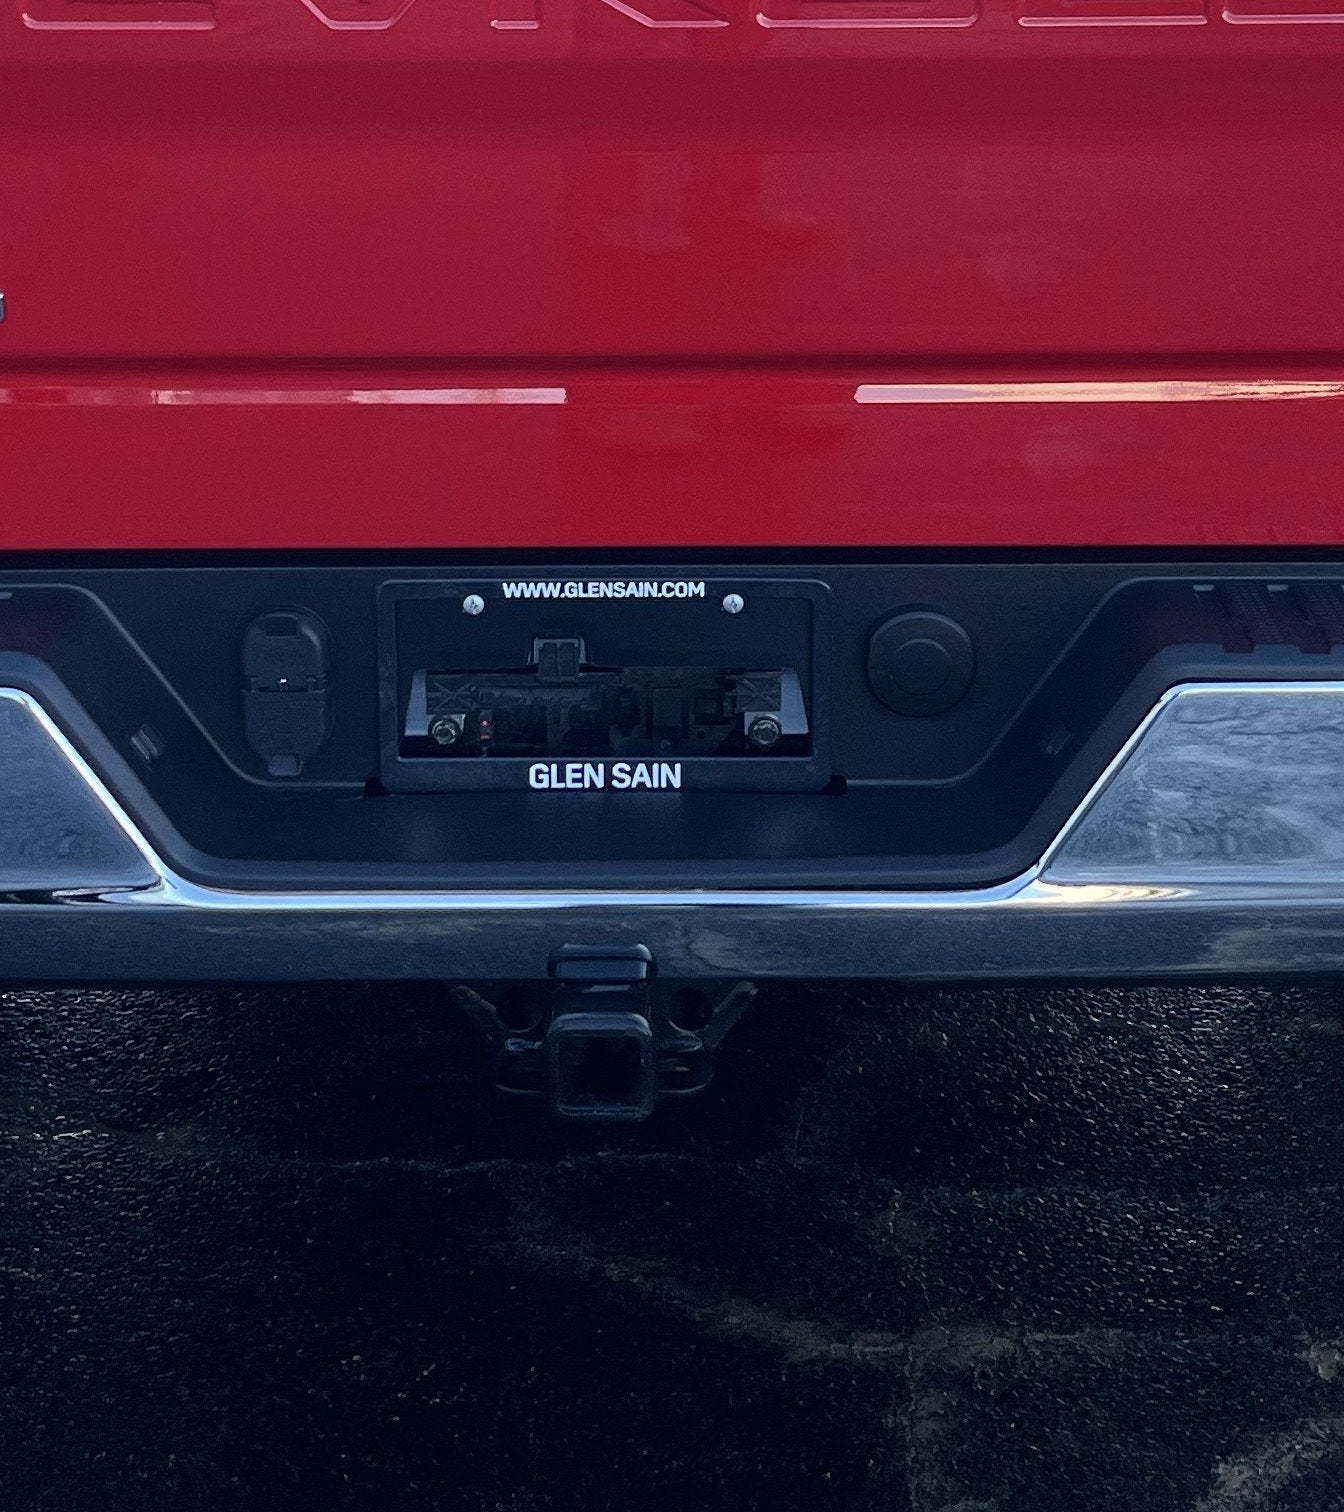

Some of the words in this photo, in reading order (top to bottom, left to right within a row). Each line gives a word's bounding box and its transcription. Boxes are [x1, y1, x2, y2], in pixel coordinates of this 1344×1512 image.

[502, 581, 706, 599] WWW.GLENSAIN.COM
[528, 763, 605, 789] GLEN
[612, 762, 682, 789] SAIN
